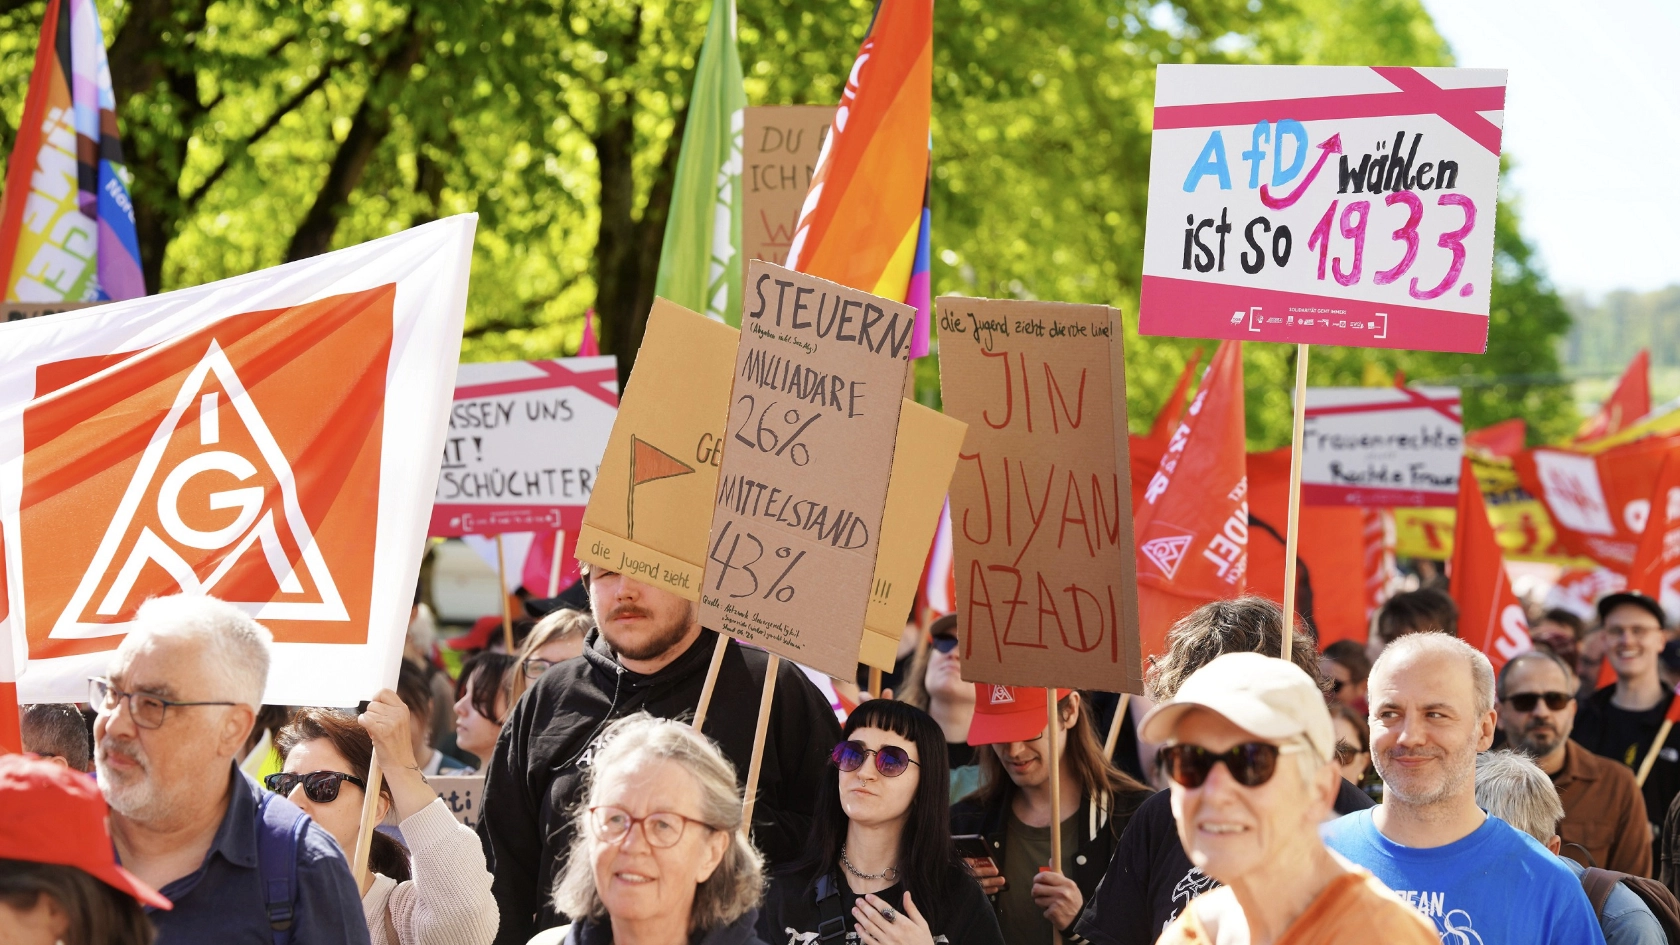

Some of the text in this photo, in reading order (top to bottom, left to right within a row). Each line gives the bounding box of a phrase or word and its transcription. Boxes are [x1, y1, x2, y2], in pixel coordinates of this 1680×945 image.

[760, 126, 804, 154] DU
[1183, 119, 1459, 195] AfD wählen
[751, 164, 797, 193] ICH
[1182, 207, 1232, 273] ist
[1307, 190, 1477, 300] 1933.
[750, 274, 914, 361] STEUERN:
[941, 309, 966, 333] die
[967, 313, 1010, 351] Jugend
[1015, 319, 1045, 338] zieht
[526, 400, 574, 422] UNS
[980, 347, 1087, 435] JIN
[734, 395, 822, 466] 26%
[718, 473, 868, 549] MITTELSTAND
[959, 452, 1121, 568] JIYAN
[591, 541, 611, 561] die
[617, 551, 660, 580] Jugend
[663, 569, 690, 589] zieht
[710, 521, 806, 603] 43%
[965, 559, 1118, 664] AZADI
